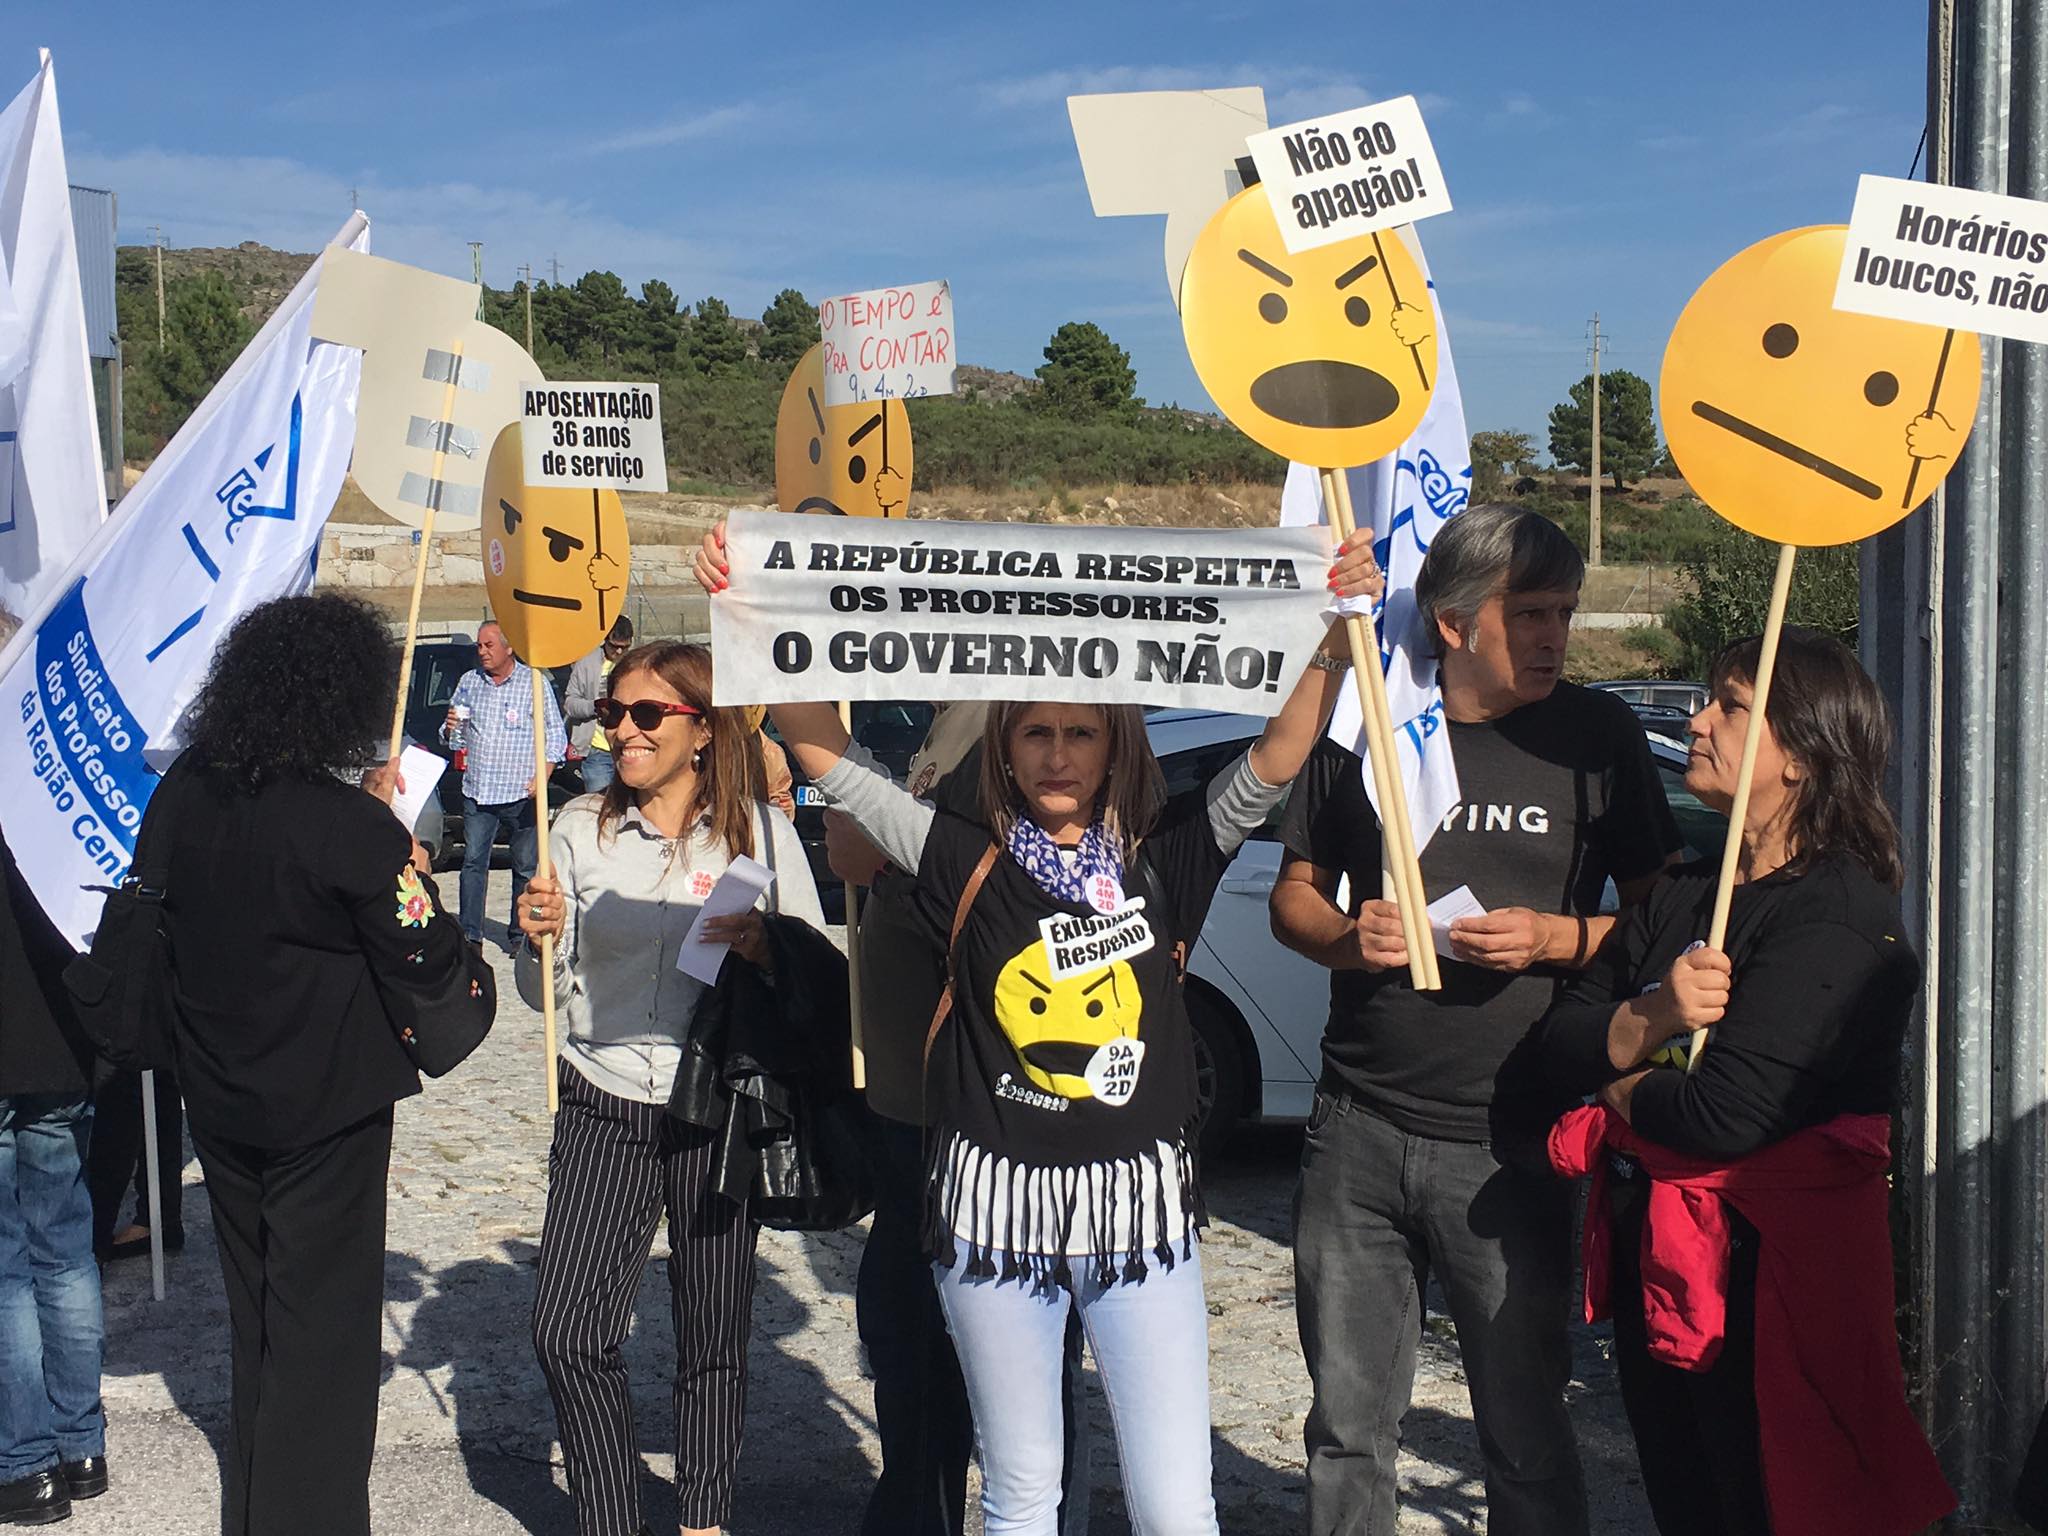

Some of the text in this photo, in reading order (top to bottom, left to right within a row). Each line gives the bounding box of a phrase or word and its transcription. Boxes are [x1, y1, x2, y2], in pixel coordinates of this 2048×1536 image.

[1282, 121, 1397, 177] Não ao
[1291, 157, 1427, 229] apagão!
[1895, 203, 2048, 264] Horários
[1853, 246, 1980, 306] loucos,
[1987, 271, 2048, 314] não
[839, 291, 915, 330] TEMPO
[824, 327, 950, 377] PRA CONTAR
[524, 387, 654, 424] APOSENTAÇÃO
[552, 420, 631, 449] 36 anos
[542, 450, 644, 483] de serviço
[763, 540, 1301, 590] A REPÚBLICA RESPEITA
[829, 584, 888, 613] OS
[772, 630, 1285, 694] O GOVERNO NÃO!
[44, 660, 68, 706] dos
[67, 630, 132, 753] Sindicato
[20, 689, 38, 724] da
[26, 717, 75, 813] Região
[1095, 888, 1115, 900] 4M
[1096, 876, 1113, 889] 9A
[1097, 899, 1115, 911] 2D
[1103, 1060, 1135, 1078] 4M
[1109, 1045, 1134, 1061] 9A
[1104, 1080, 1131, 1096] 2D
